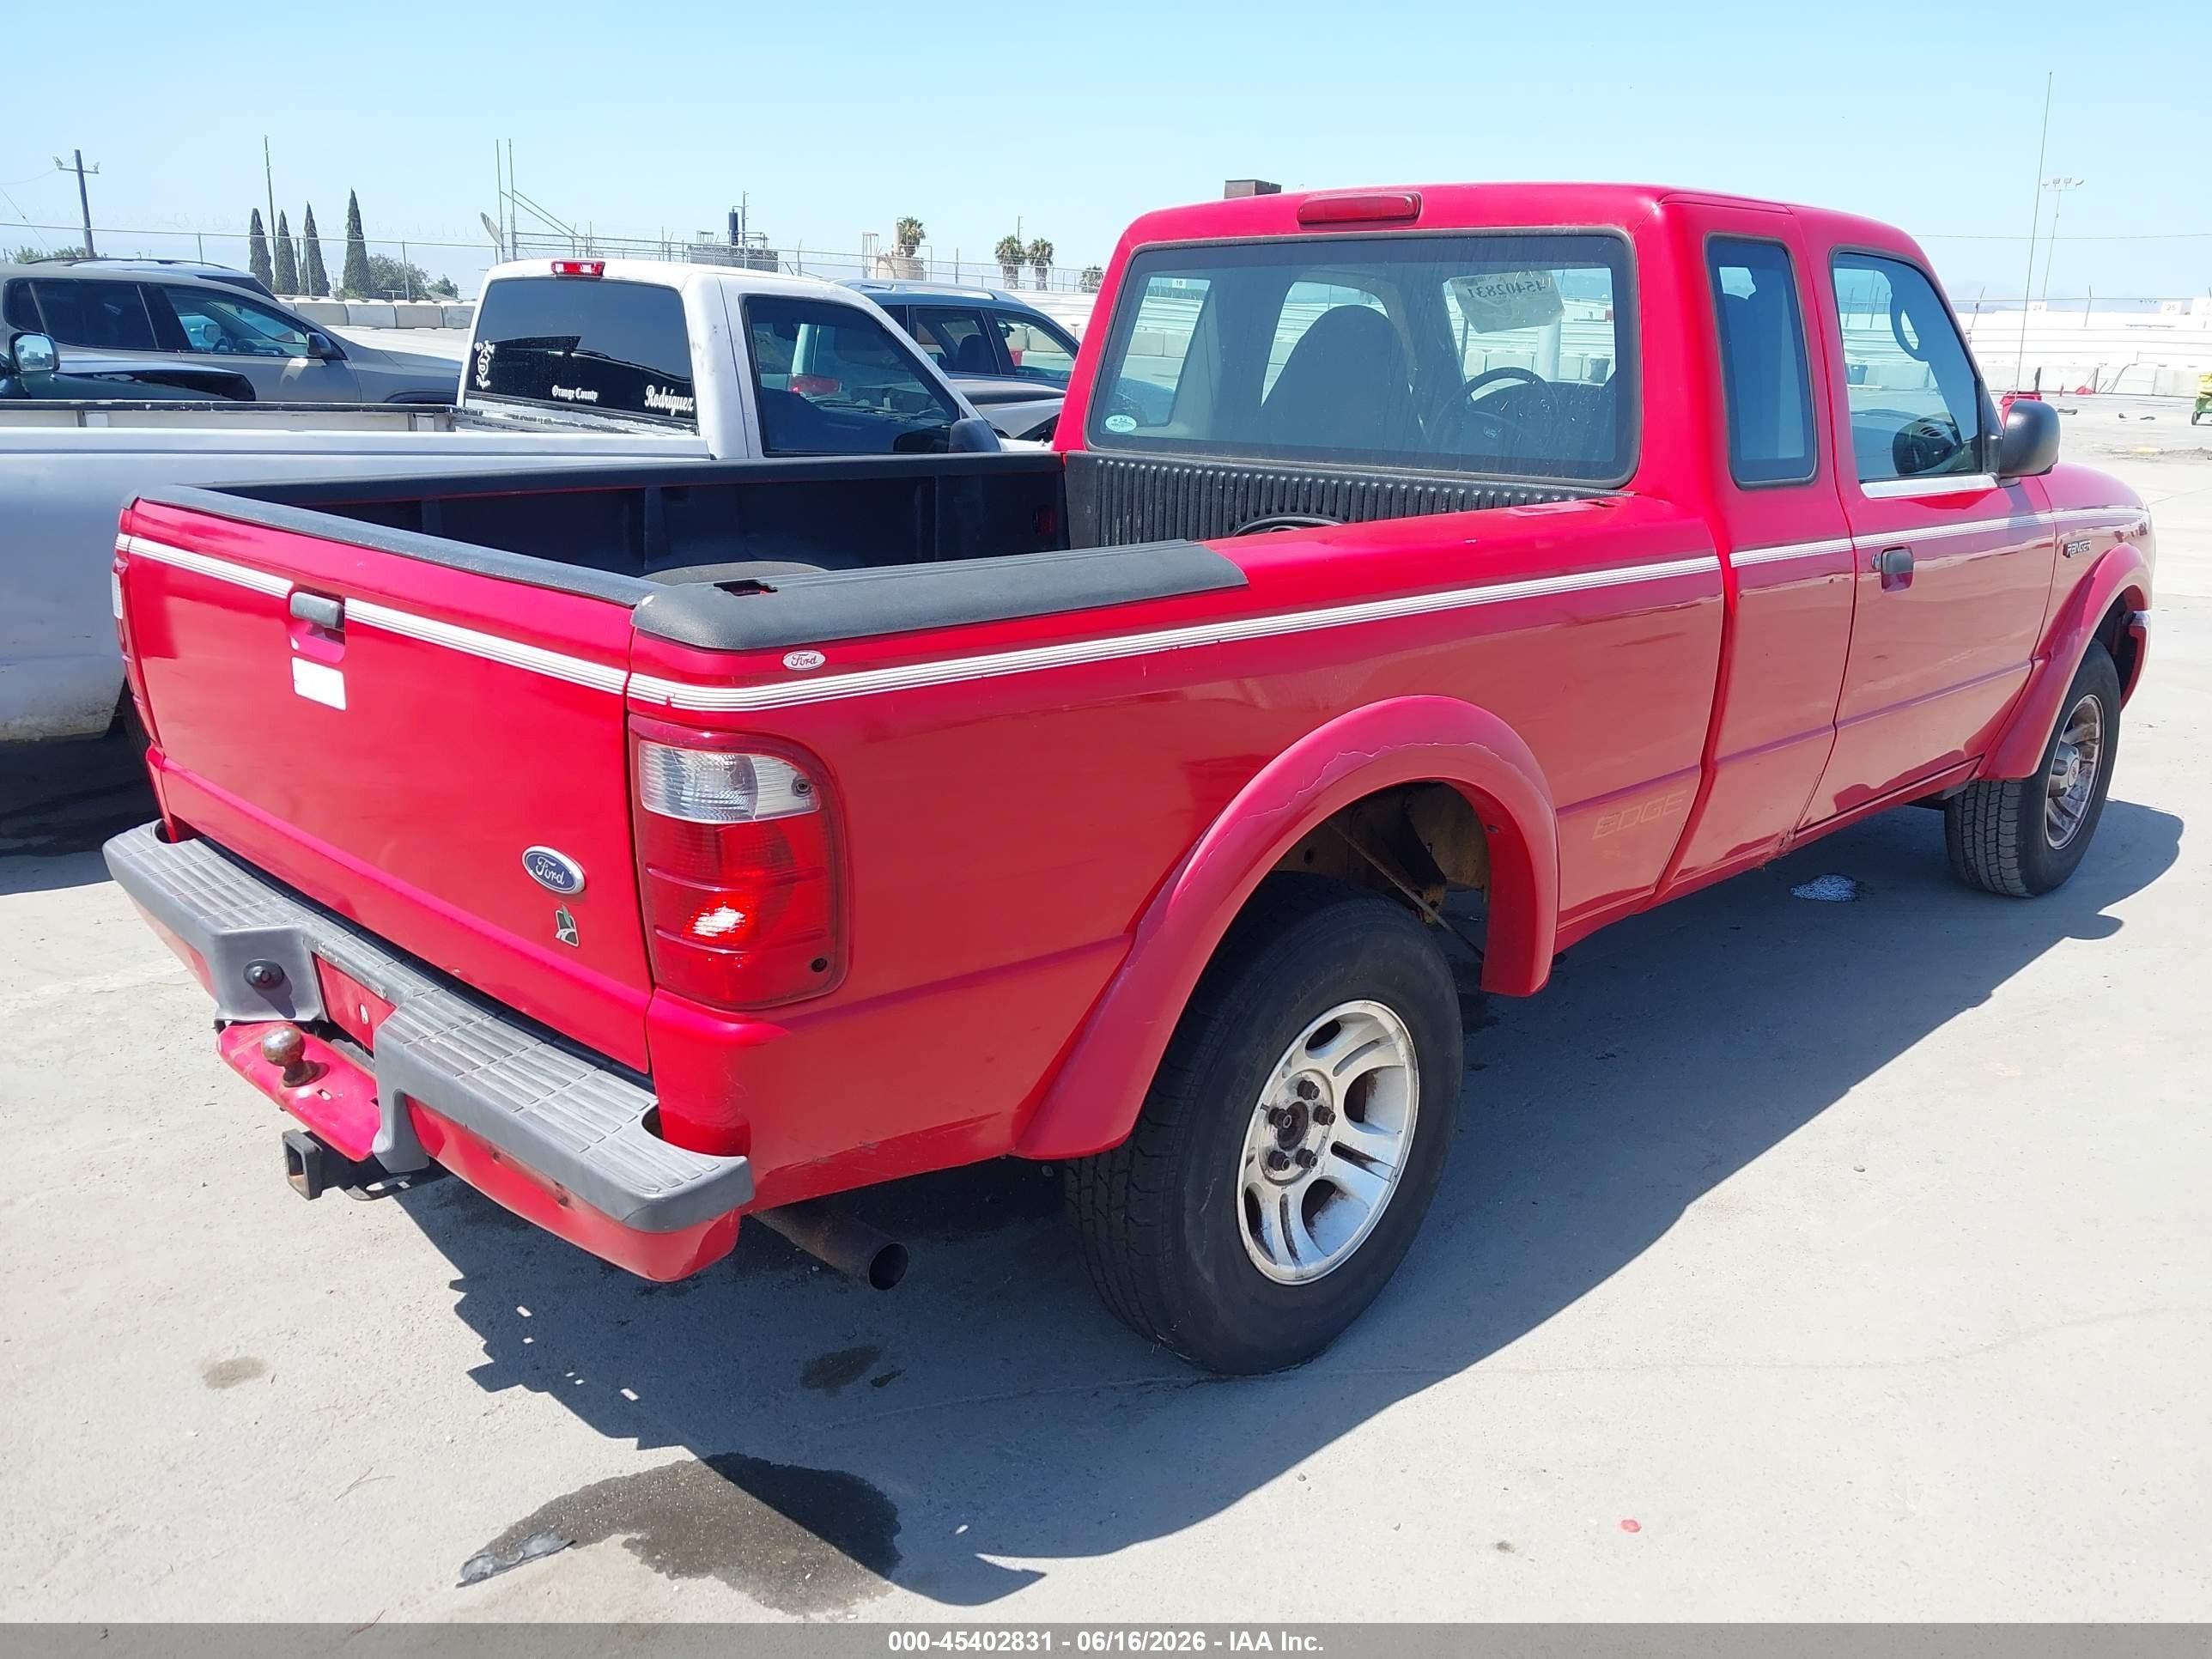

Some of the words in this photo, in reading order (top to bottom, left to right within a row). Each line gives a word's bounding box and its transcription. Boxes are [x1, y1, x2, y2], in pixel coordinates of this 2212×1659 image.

[551, 384, 575, 401] Orange
[575, 386, 599, 403] County
[790, 653, 818, 666] Ford
[1592, 789, 1688, 839] EDGE
[535, 856, 565, 885] Ford
